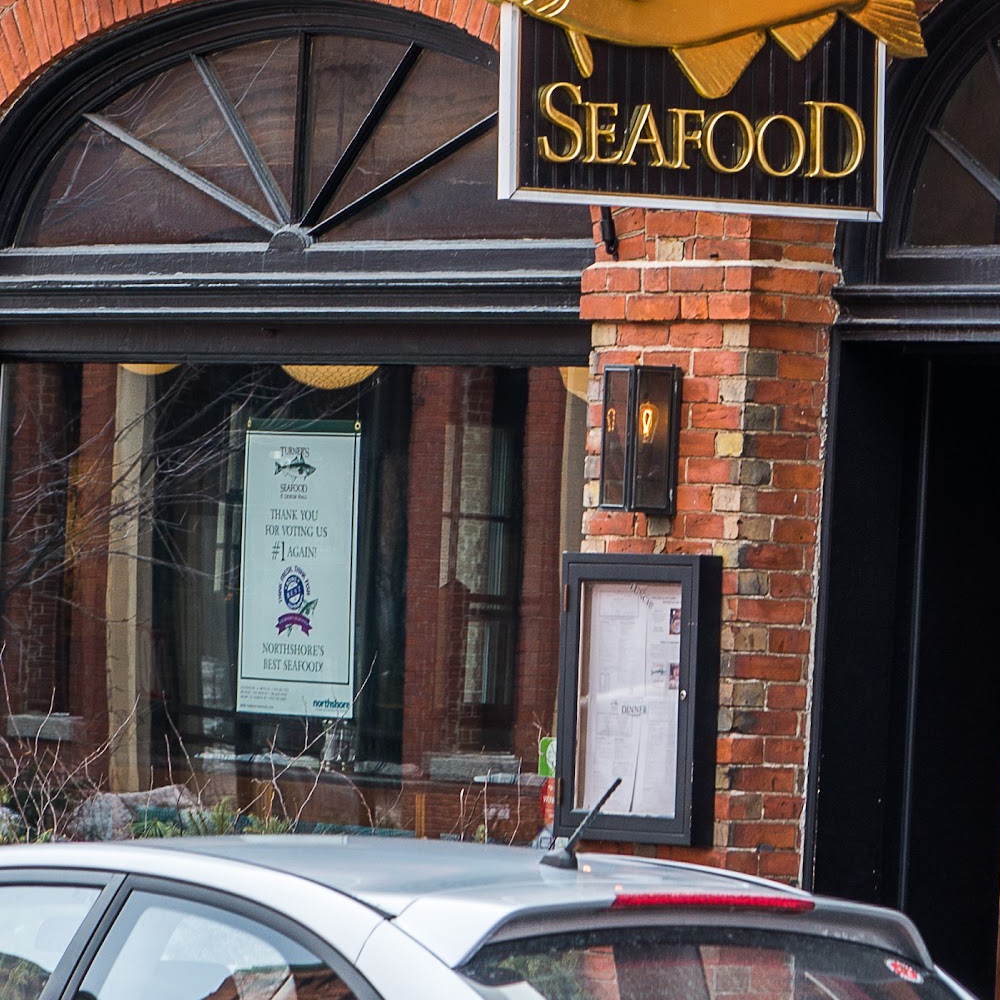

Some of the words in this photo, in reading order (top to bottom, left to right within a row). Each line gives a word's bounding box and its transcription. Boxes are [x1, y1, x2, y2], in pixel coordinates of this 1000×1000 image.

[538, 82, 865, 179] SEAFOOD
[280, 483, 308, 493] SEAFOOD
[270, 508, 298, 520] THANK
[300, 509, 319, 521] YOU
[265, 524, 280, 536] FOR
[281, 525, 313, 537] VOTING
[316, 526, 328, 538] US
[271, 540, 285, 561] #1
[286, 545, 317, 558] AGAIN!
[262, 642, 325, 656] NORTHSHORE'S
[263, 658, 281, 670] BEST
[283, 659, 324, 672] SEAFOOD!
[312, 698, 351, 709] northshore
[621, 704, 648, 714] DINNER
